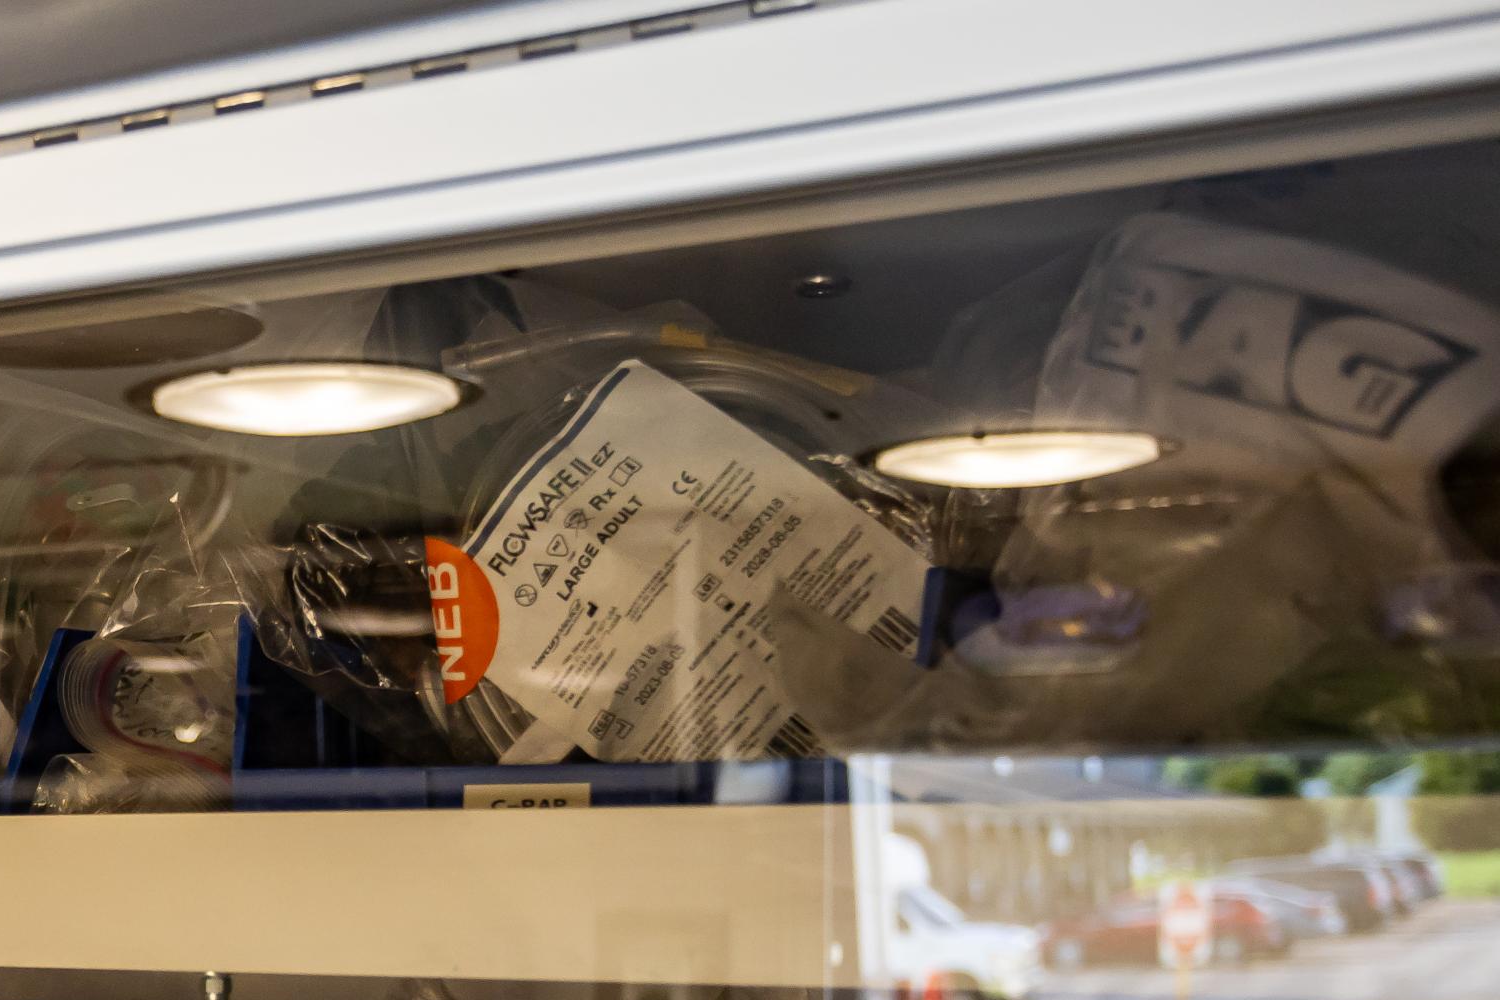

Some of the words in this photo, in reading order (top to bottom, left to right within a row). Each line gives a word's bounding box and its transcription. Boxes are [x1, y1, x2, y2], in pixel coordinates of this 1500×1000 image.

[556, 543, 600, 601] LARGE
[594, 495, 643, 545] ADULT
[427, 562, 466, 681] NEB
